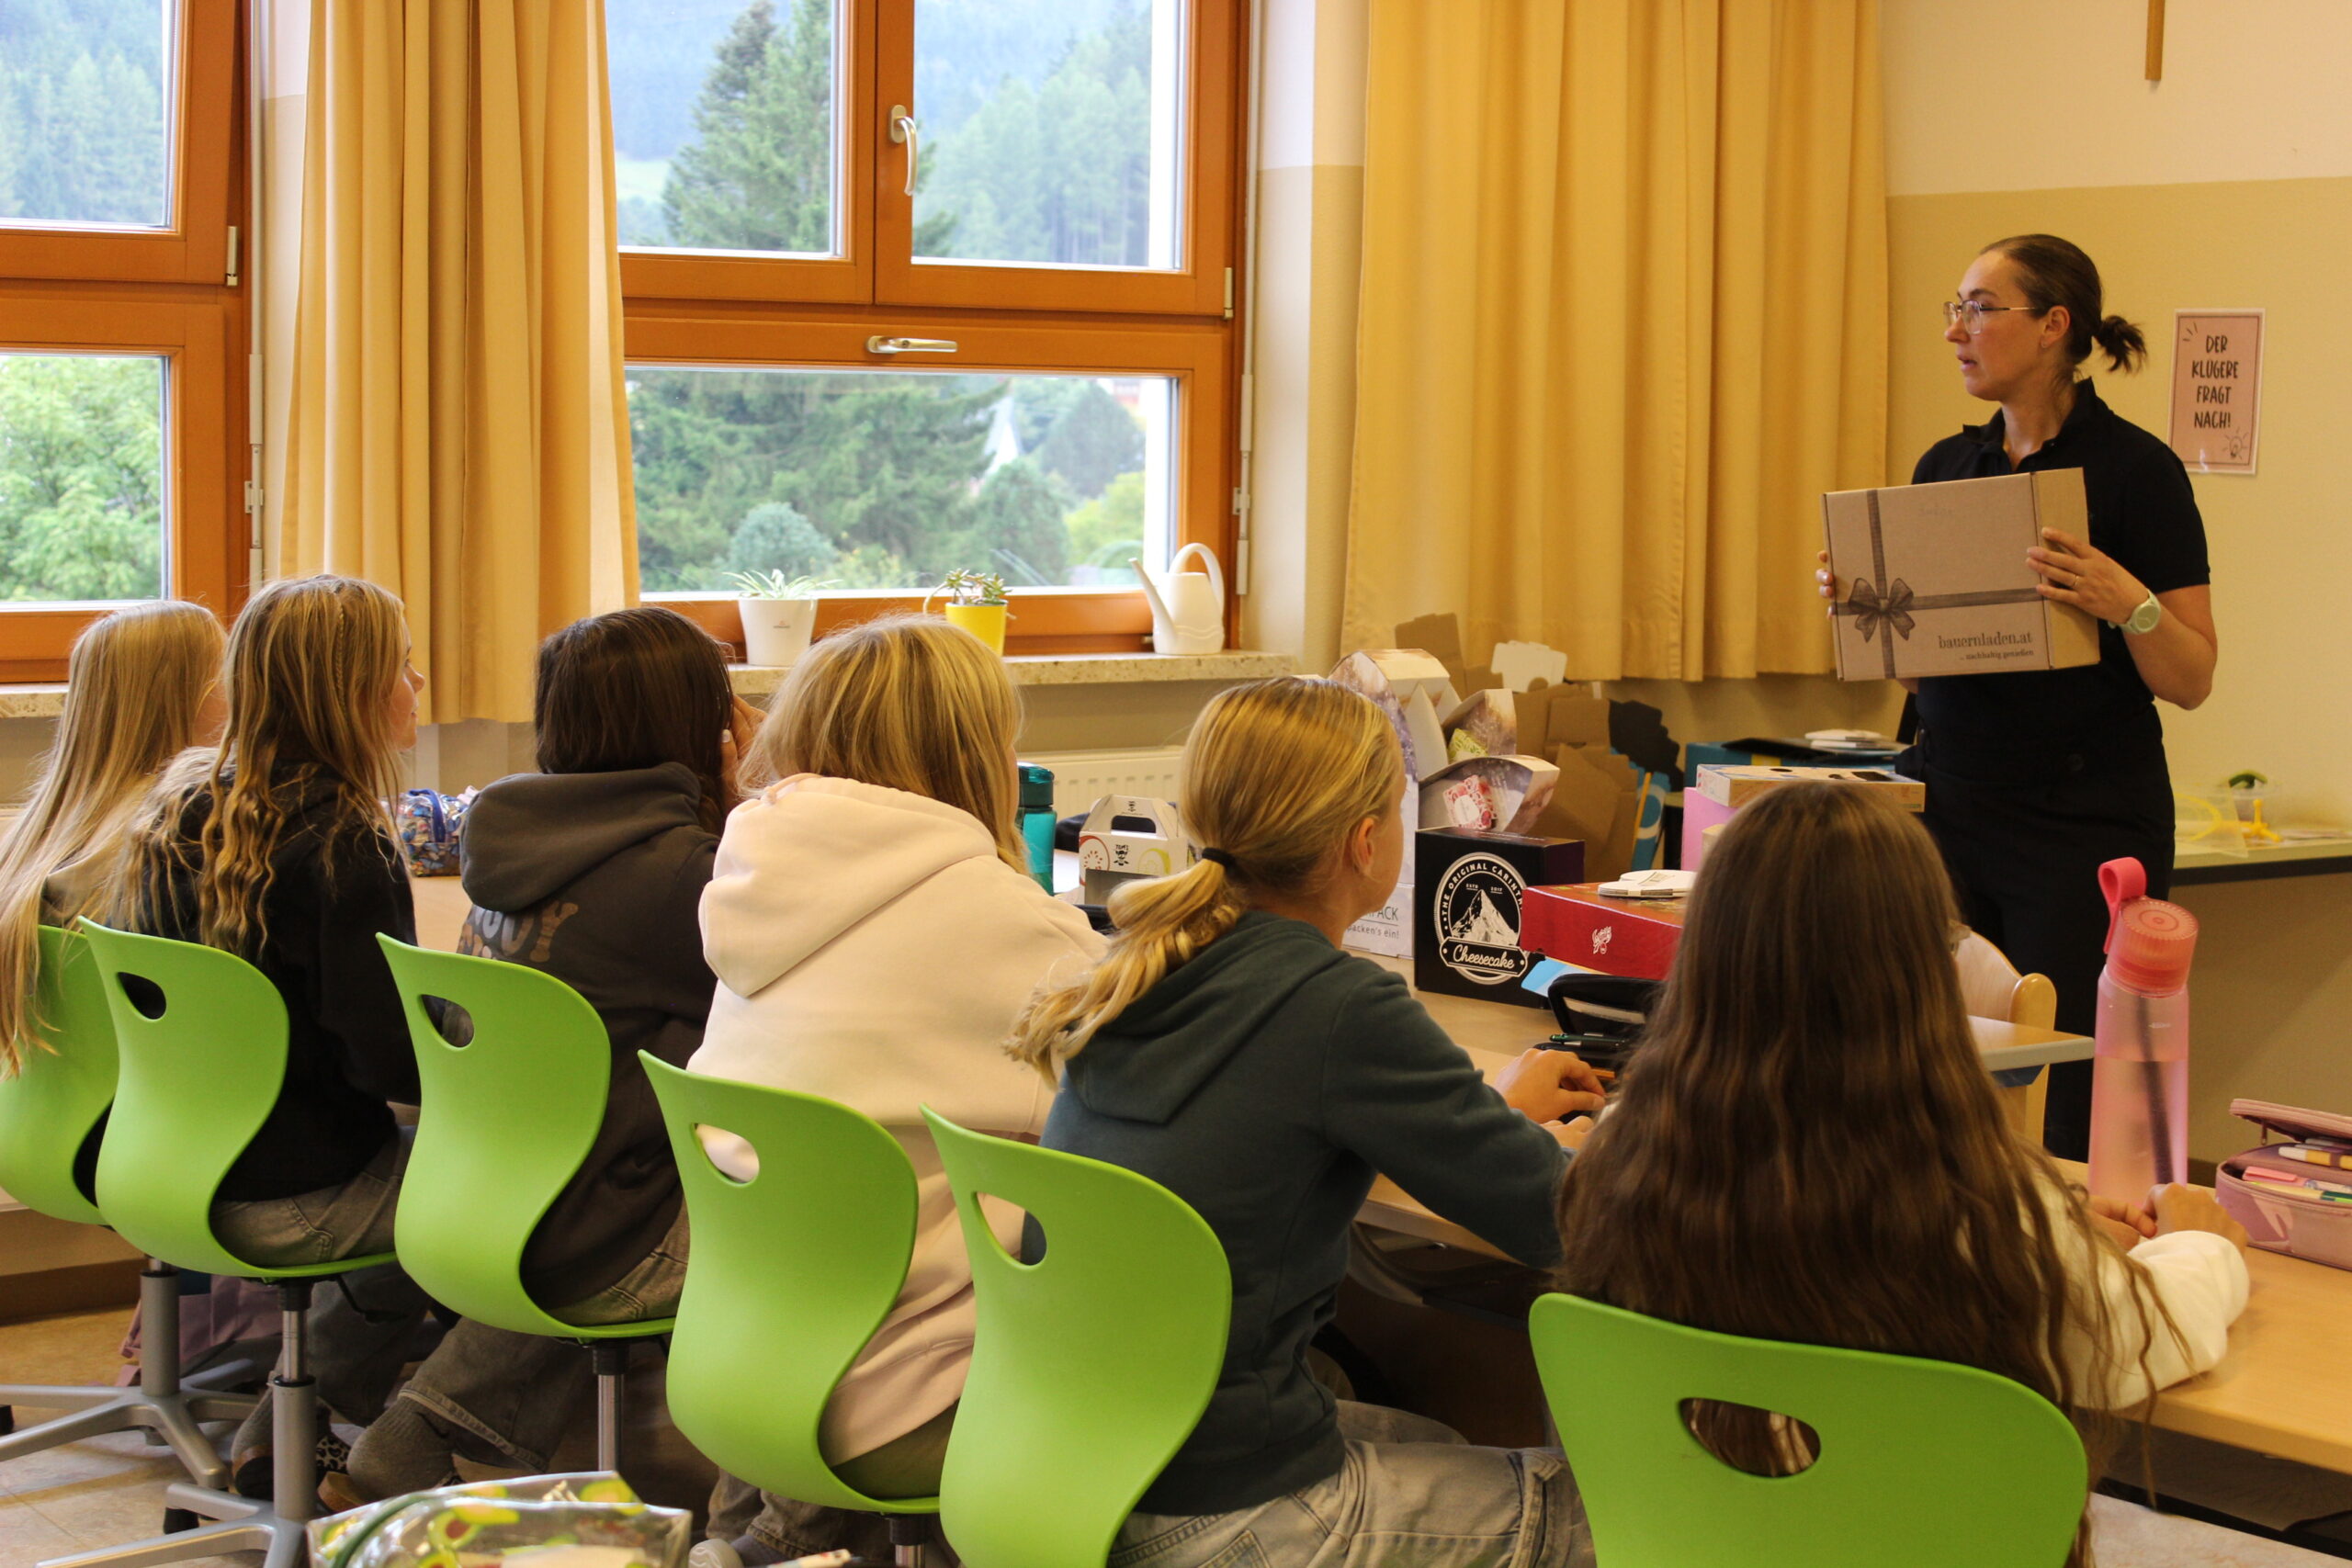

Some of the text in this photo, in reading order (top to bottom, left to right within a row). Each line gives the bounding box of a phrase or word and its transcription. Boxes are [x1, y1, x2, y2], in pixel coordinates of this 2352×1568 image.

[2206, 335, 2228, 353] DER
[2197, 385, 2232, 404] FRAGT
[2194, 412, 2232, 429] NACH!
[1938, 631, 2033, 649] bauernladen.at
[1442, 895, 1451, 916] THE
[1448, 863, 1487, 889] ORIGINAL
[1453, 944, 1515, 969] Cheesecake
